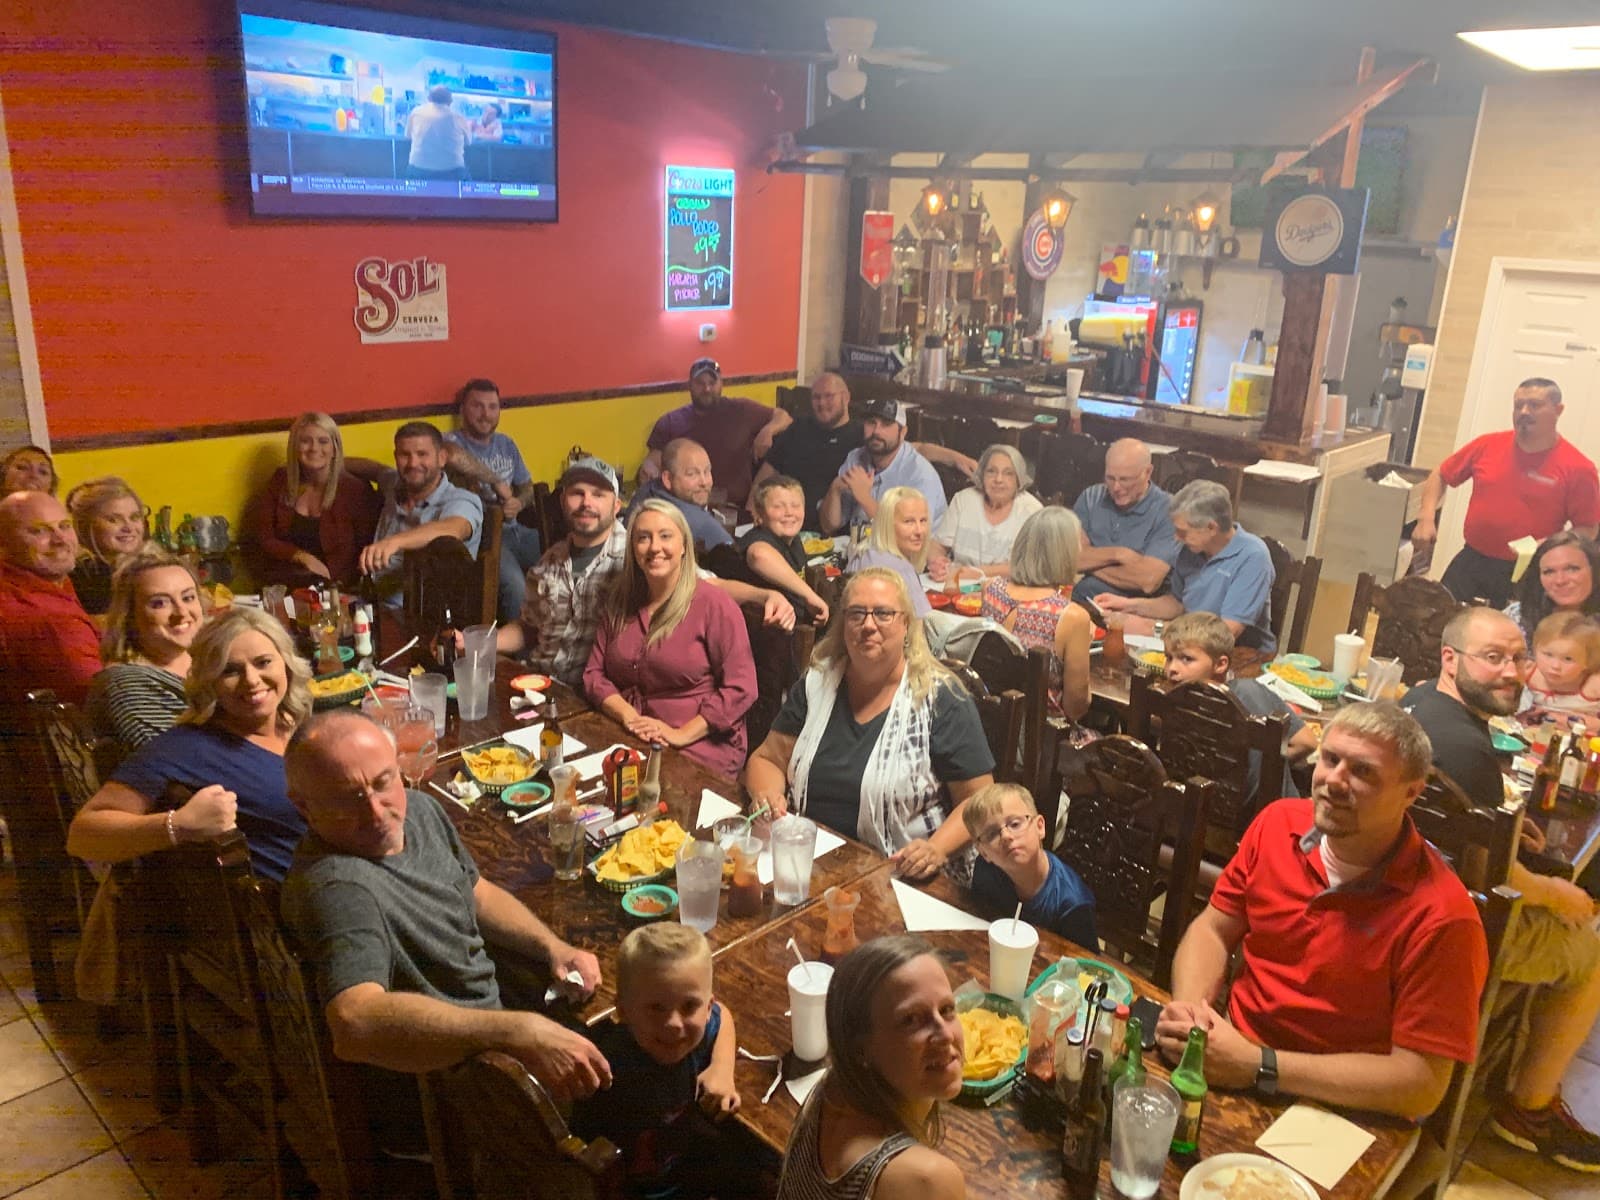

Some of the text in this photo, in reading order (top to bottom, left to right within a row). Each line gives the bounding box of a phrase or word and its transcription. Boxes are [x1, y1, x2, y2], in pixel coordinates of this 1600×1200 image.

[262, 175, 287, 184] ESPN
[704, 179, 733, 191] LIGHT
[670, 208, 697, 226] POLLO
[354, 257, 440, 335] SOL
[402, 316, 439, 324] CERVEZA
